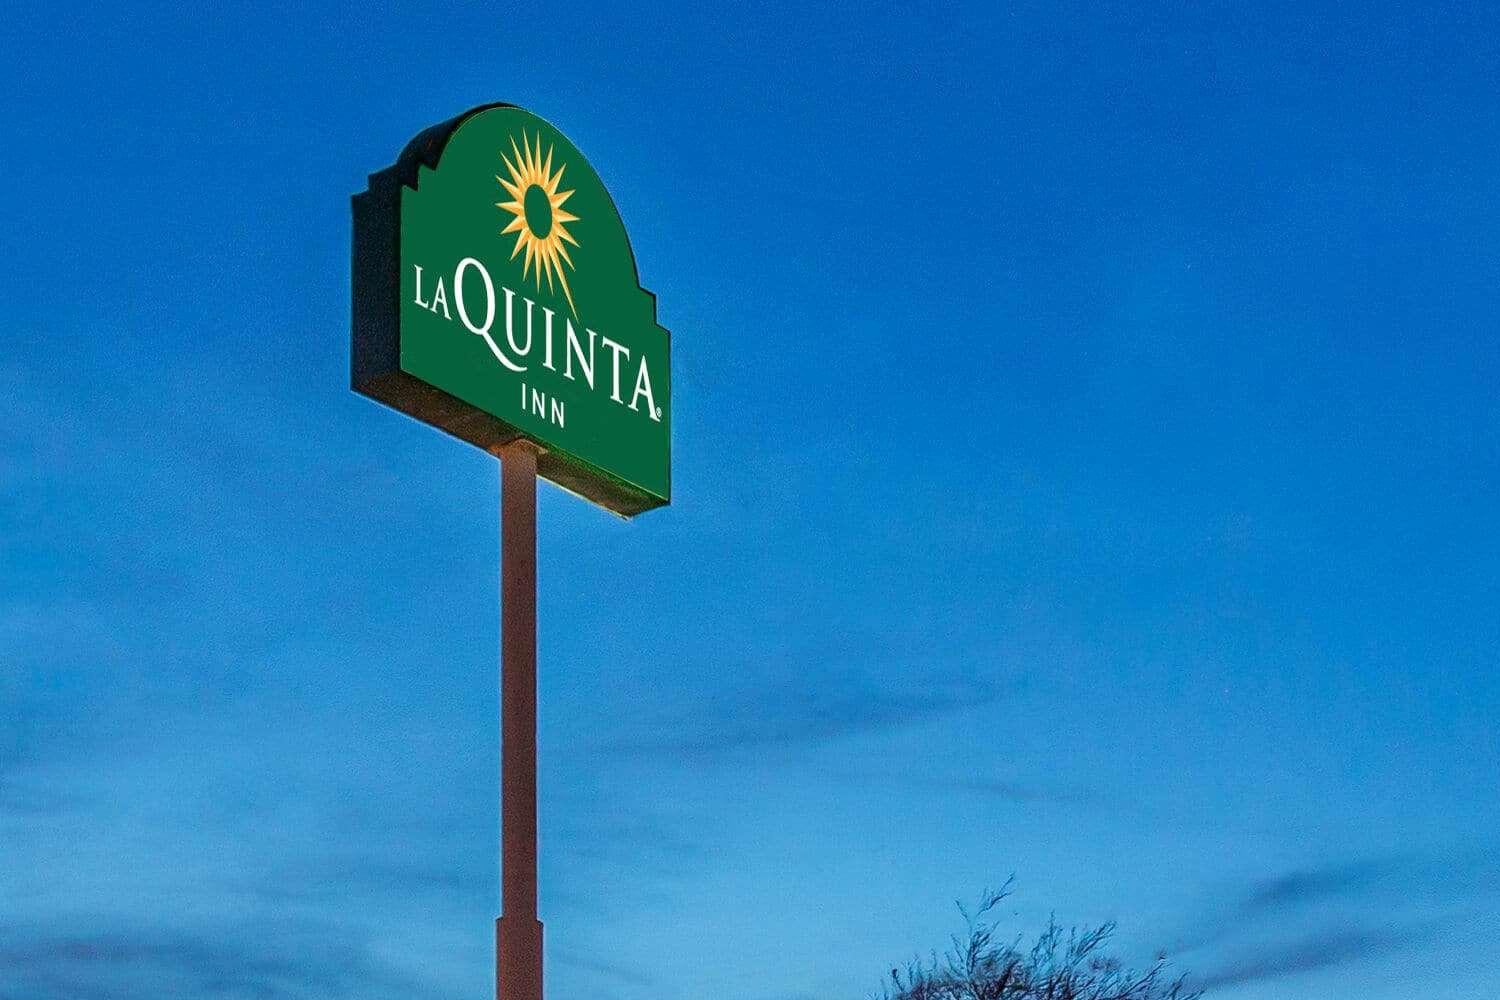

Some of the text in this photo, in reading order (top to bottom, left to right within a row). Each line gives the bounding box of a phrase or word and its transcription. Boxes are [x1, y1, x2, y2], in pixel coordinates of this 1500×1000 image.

[414, 257, 661, 422] LA QUINTA
[521, 382, 565, 429] INN
